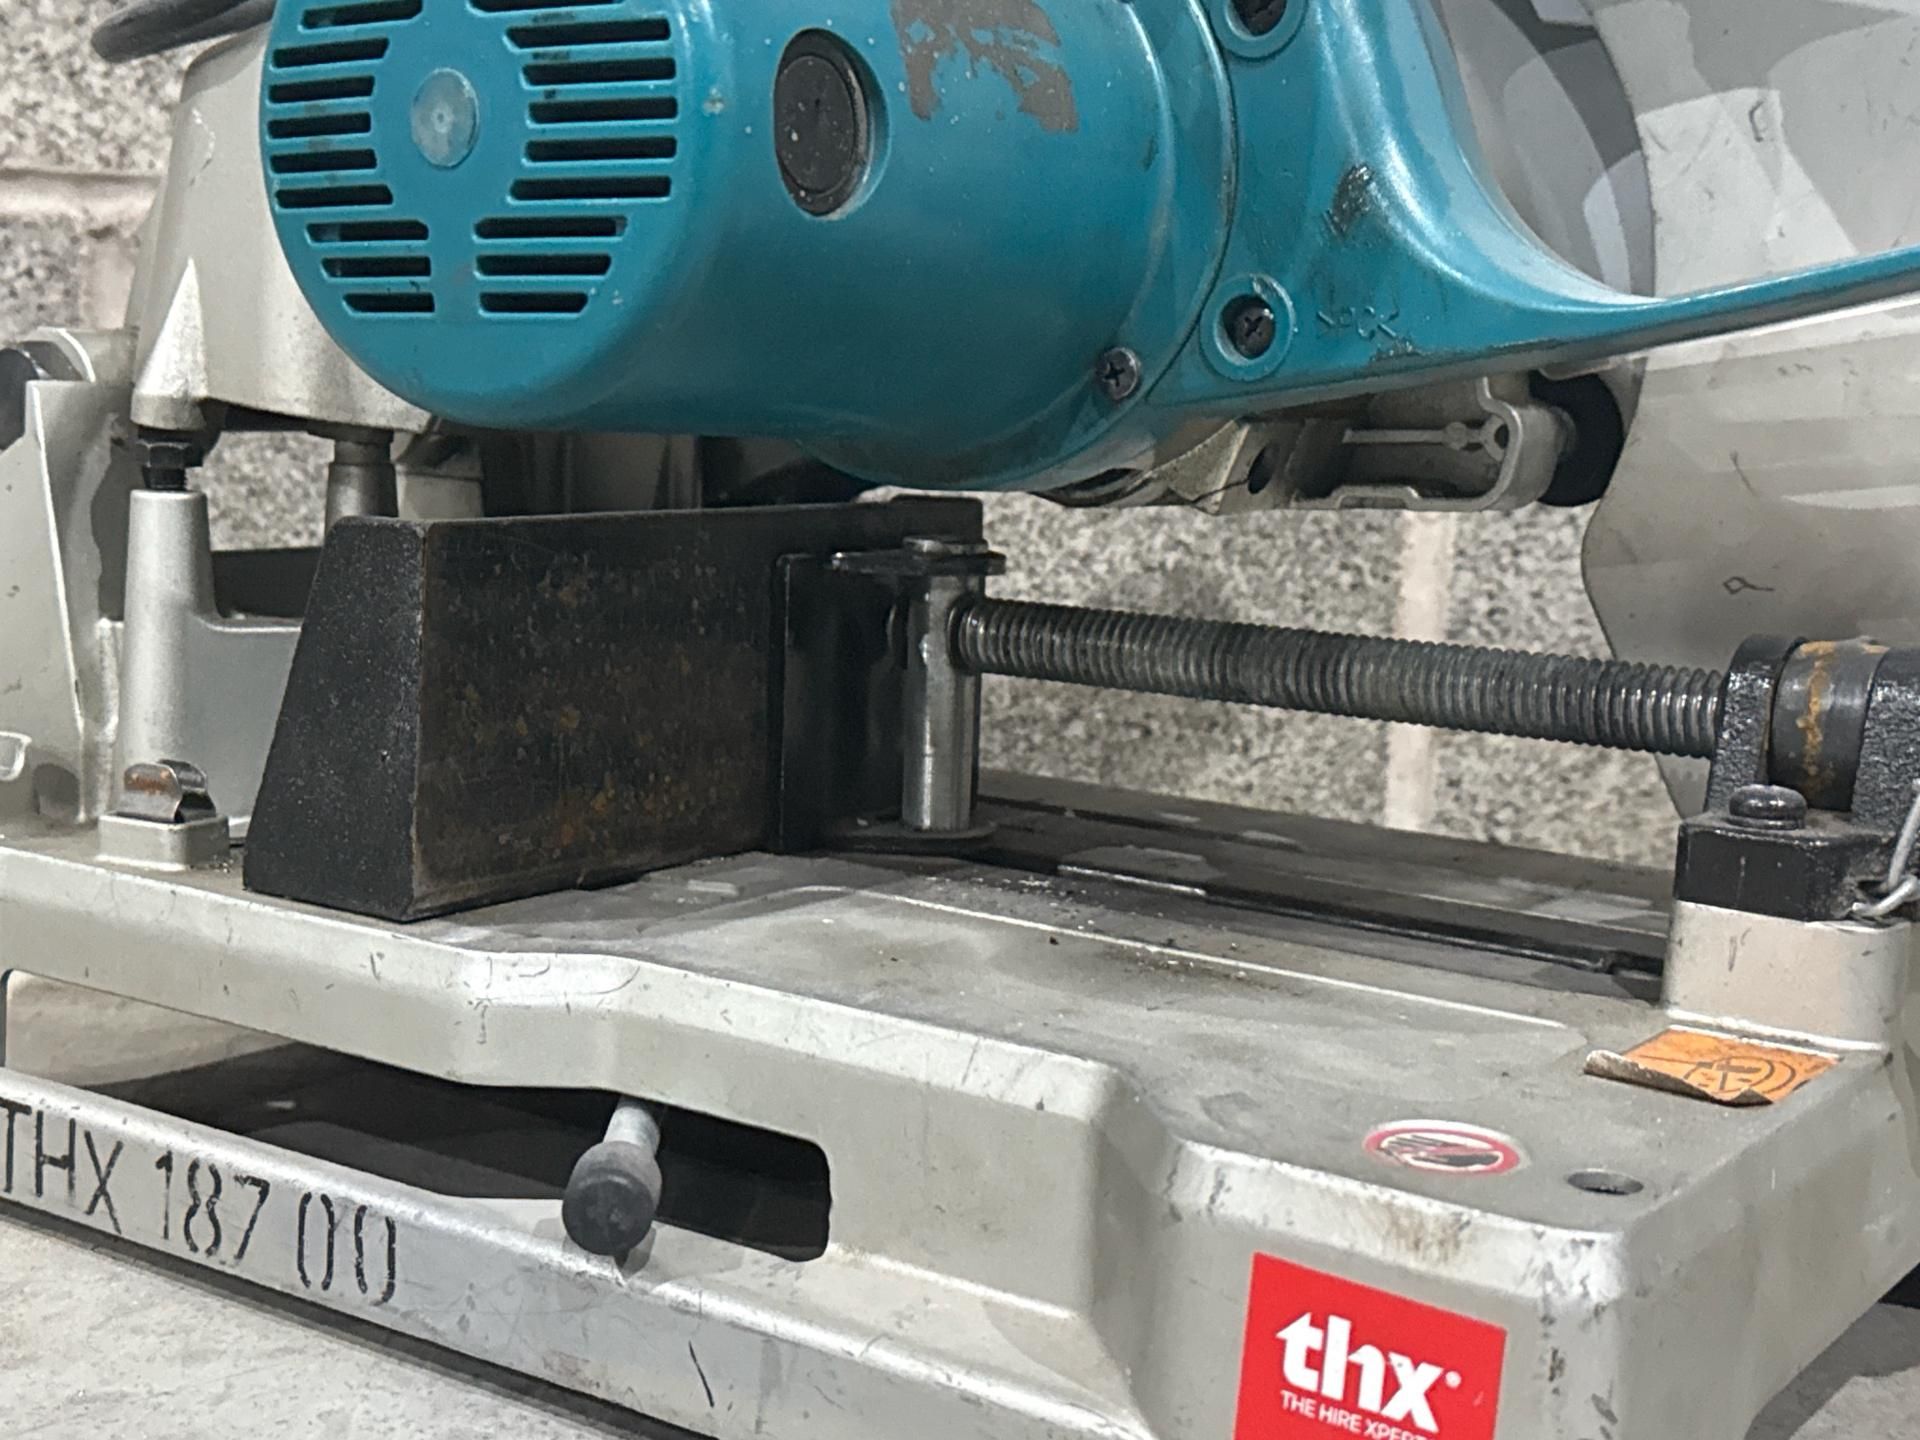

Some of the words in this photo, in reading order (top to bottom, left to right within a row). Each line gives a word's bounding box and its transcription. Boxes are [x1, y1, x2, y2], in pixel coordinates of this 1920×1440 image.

[0, 1097, 123, 1235] THX
[1275, 1312, 1443, 1434] thx
[1281, 1389, 1317, 1419] THE
[1318, 1403, 1363, 1434] HIRE
